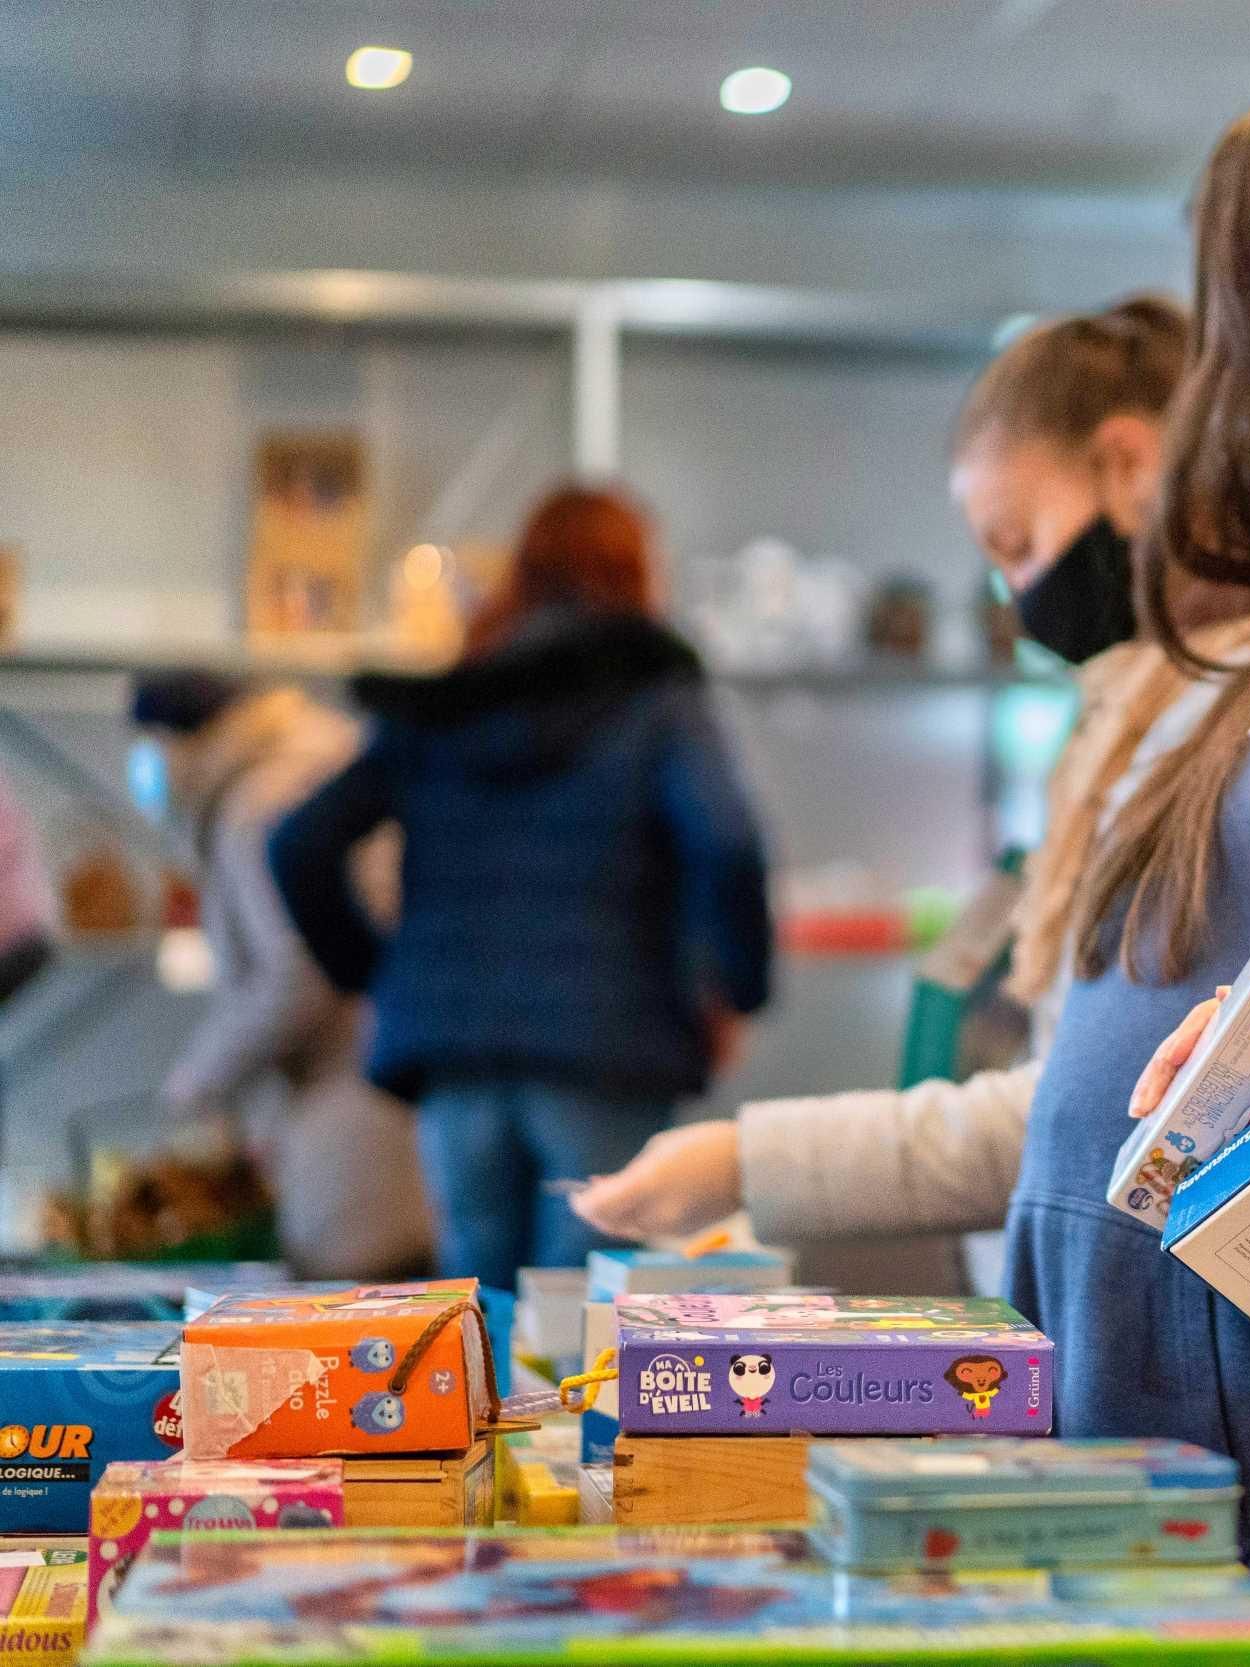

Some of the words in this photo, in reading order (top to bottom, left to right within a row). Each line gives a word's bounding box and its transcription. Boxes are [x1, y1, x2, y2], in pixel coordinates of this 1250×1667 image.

[656, 1360, 673, 1370] MA
[817, 1361, 843, 1378] Les
[433, 1372, 450, 1393] 2+
[640, 1362, 712, 1392] BOÎTE
[790, 1371, 935, 1406] Couleurs
[1027, 1366, 1041, 1408] Gründ
[640, 1389, 712, 1415] D'ÉVEIL
[2, 1487, 12, 1496] de
[14, 1487, 44, 1498] logique
